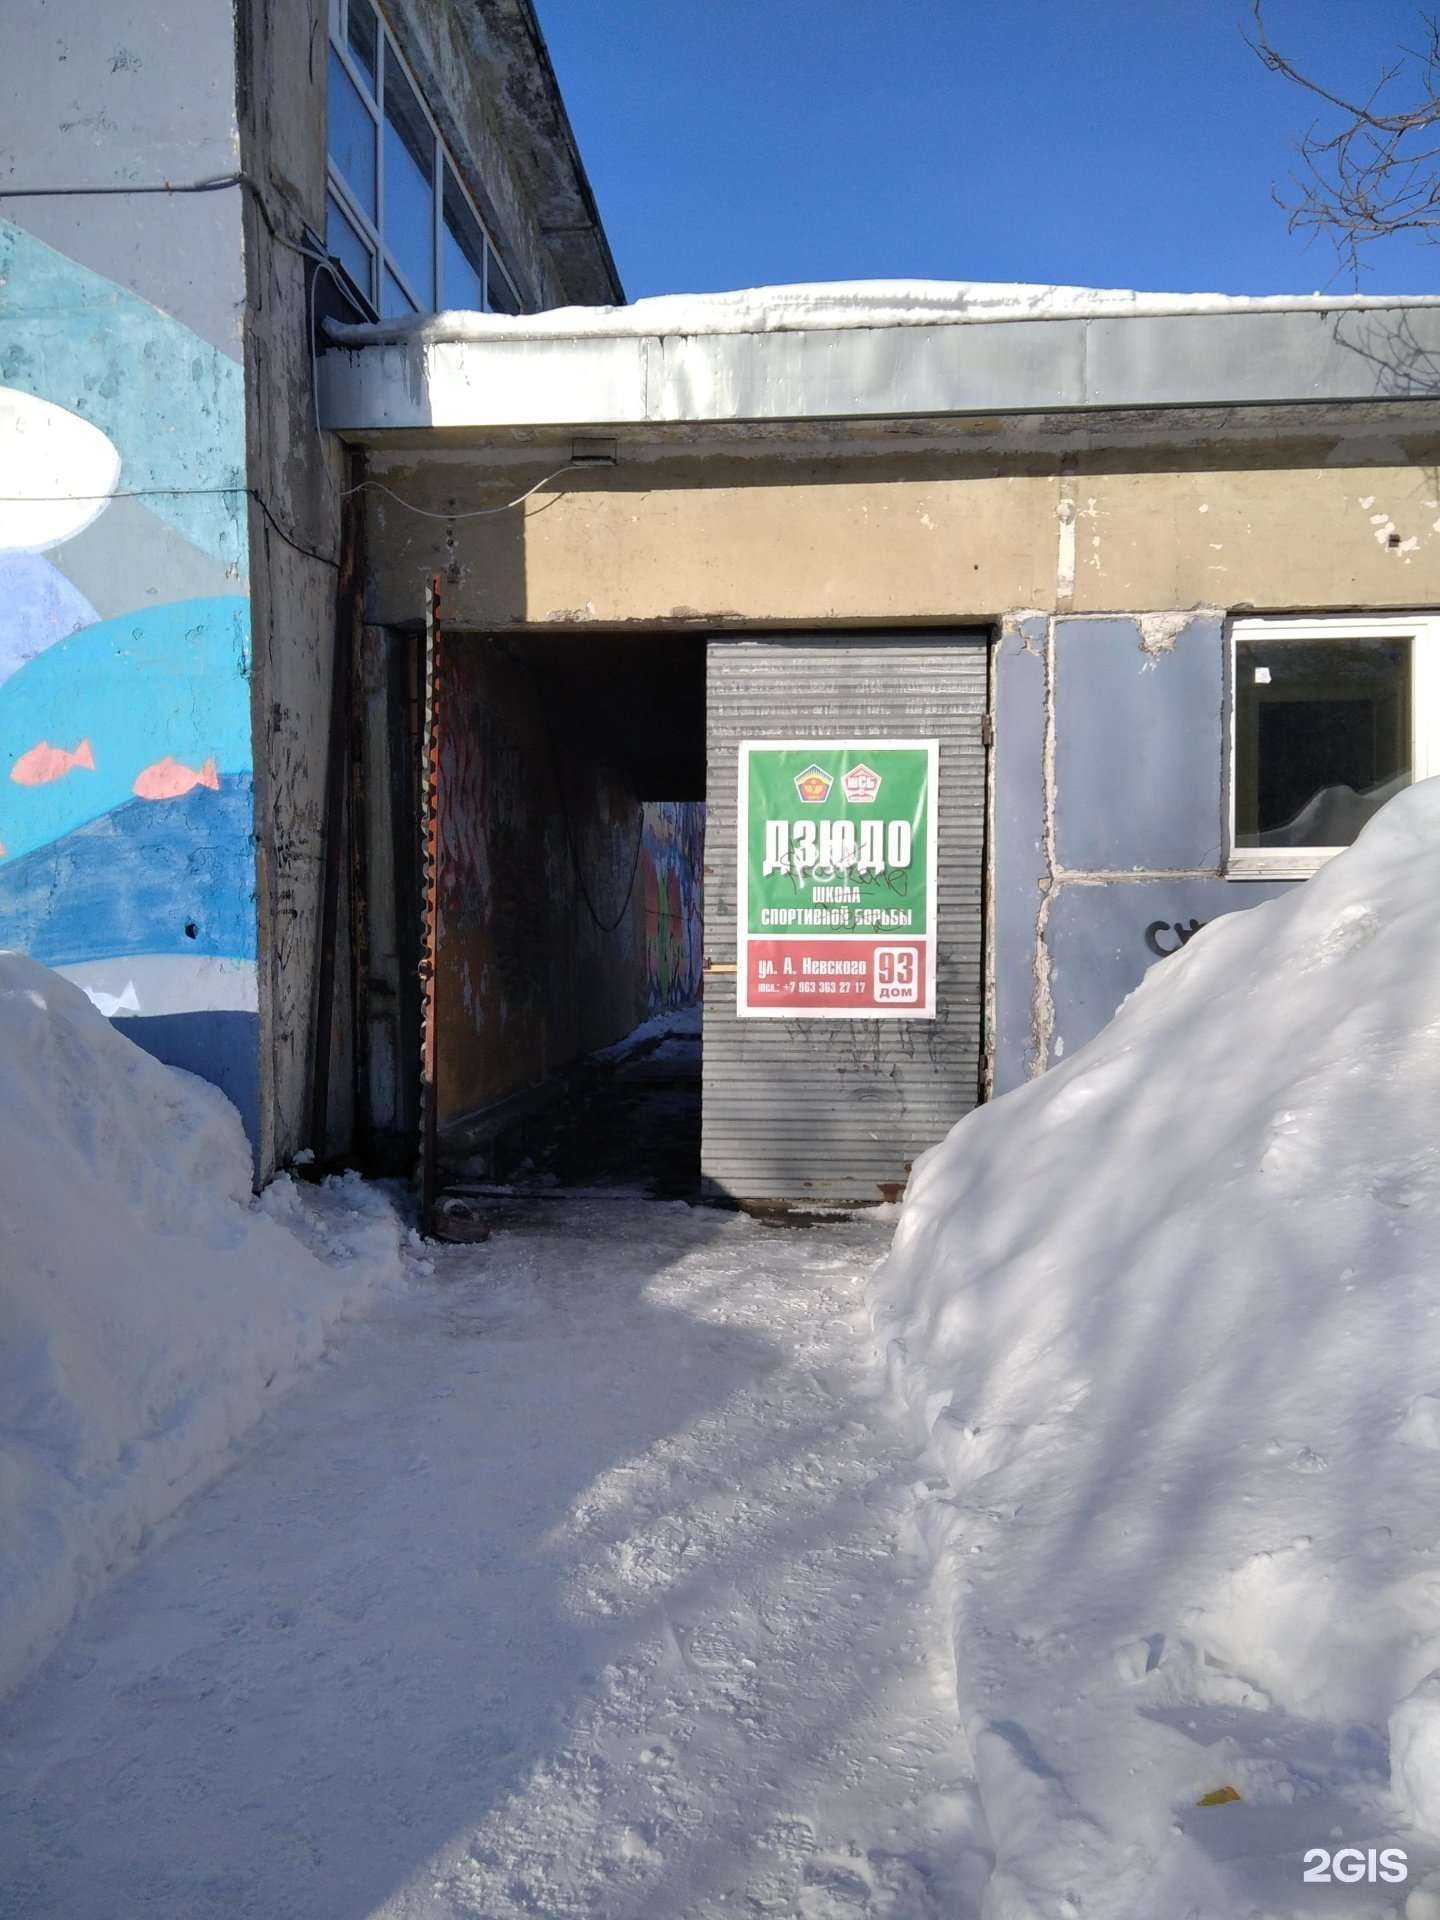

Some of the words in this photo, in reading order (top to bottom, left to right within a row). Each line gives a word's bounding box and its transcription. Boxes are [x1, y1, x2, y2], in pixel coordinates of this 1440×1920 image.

[762, 819, 912, 877] ДЗЮДО
[812, 886, 861, 903] ШКОЛА
[761, 906, 849, 926] СПОРТИВНОЙ
[855, 908, 912, 926] БОРЬБЫ
[758, 959, 778, 979] ул.
[783, 957, 797, 975] А.
[802, 957, 867, 976] Невского
[879, 952, 914, 984] 93
[782, 981, 796, 993] +7
[839, 981, 851, 993] 27
[855, 981, 866, 993] 17
[879, 987, 913, 999] ДОМ
